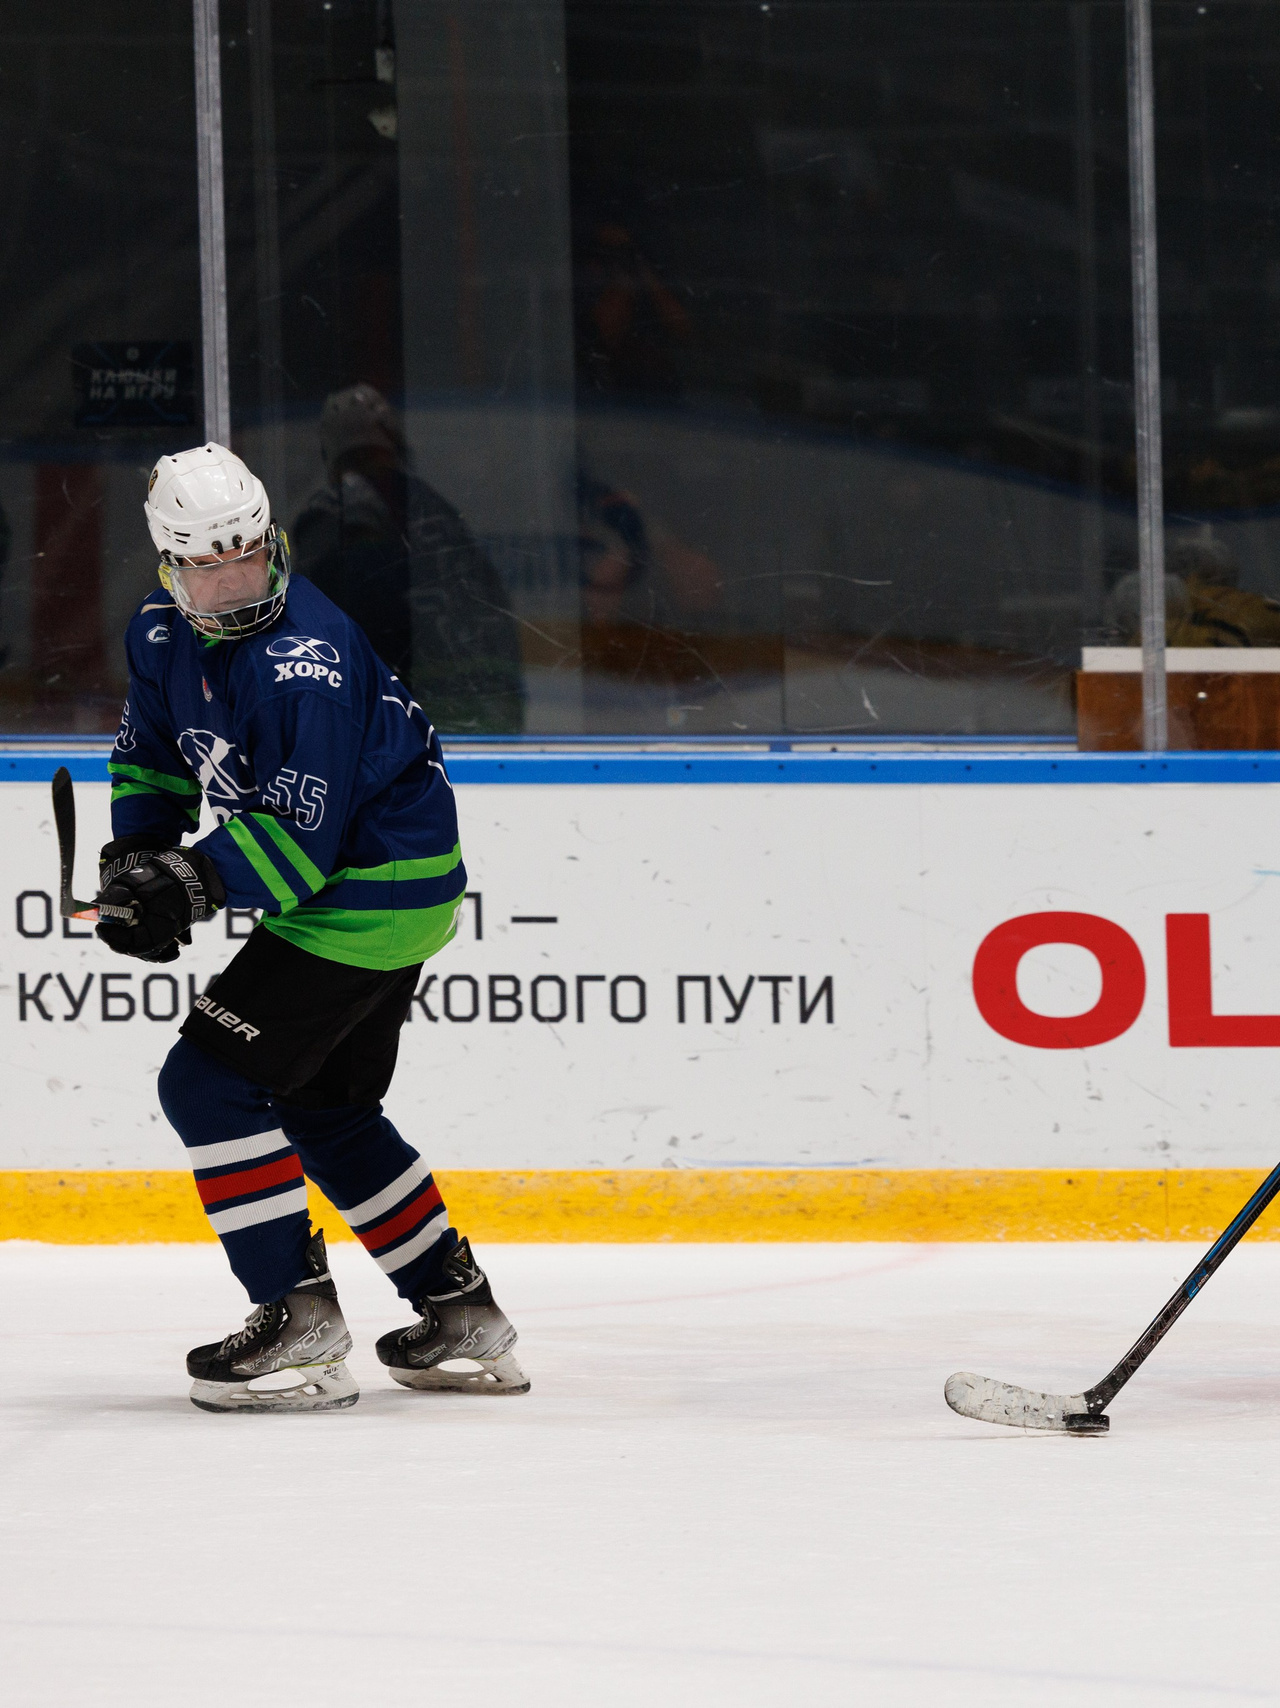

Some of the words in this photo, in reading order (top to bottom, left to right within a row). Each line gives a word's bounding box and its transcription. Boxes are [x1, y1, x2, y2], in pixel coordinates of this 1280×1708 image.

[89, 384, 117, 400] НА
[274, 661, 343, 688] ХОРС
[262, 767, 328, 831] 55
[194, 994, 261, 1042] AUER
[405, 973, 647, 1023] КОВОГО
[677, 974, 834, 1024] ПУТИ
